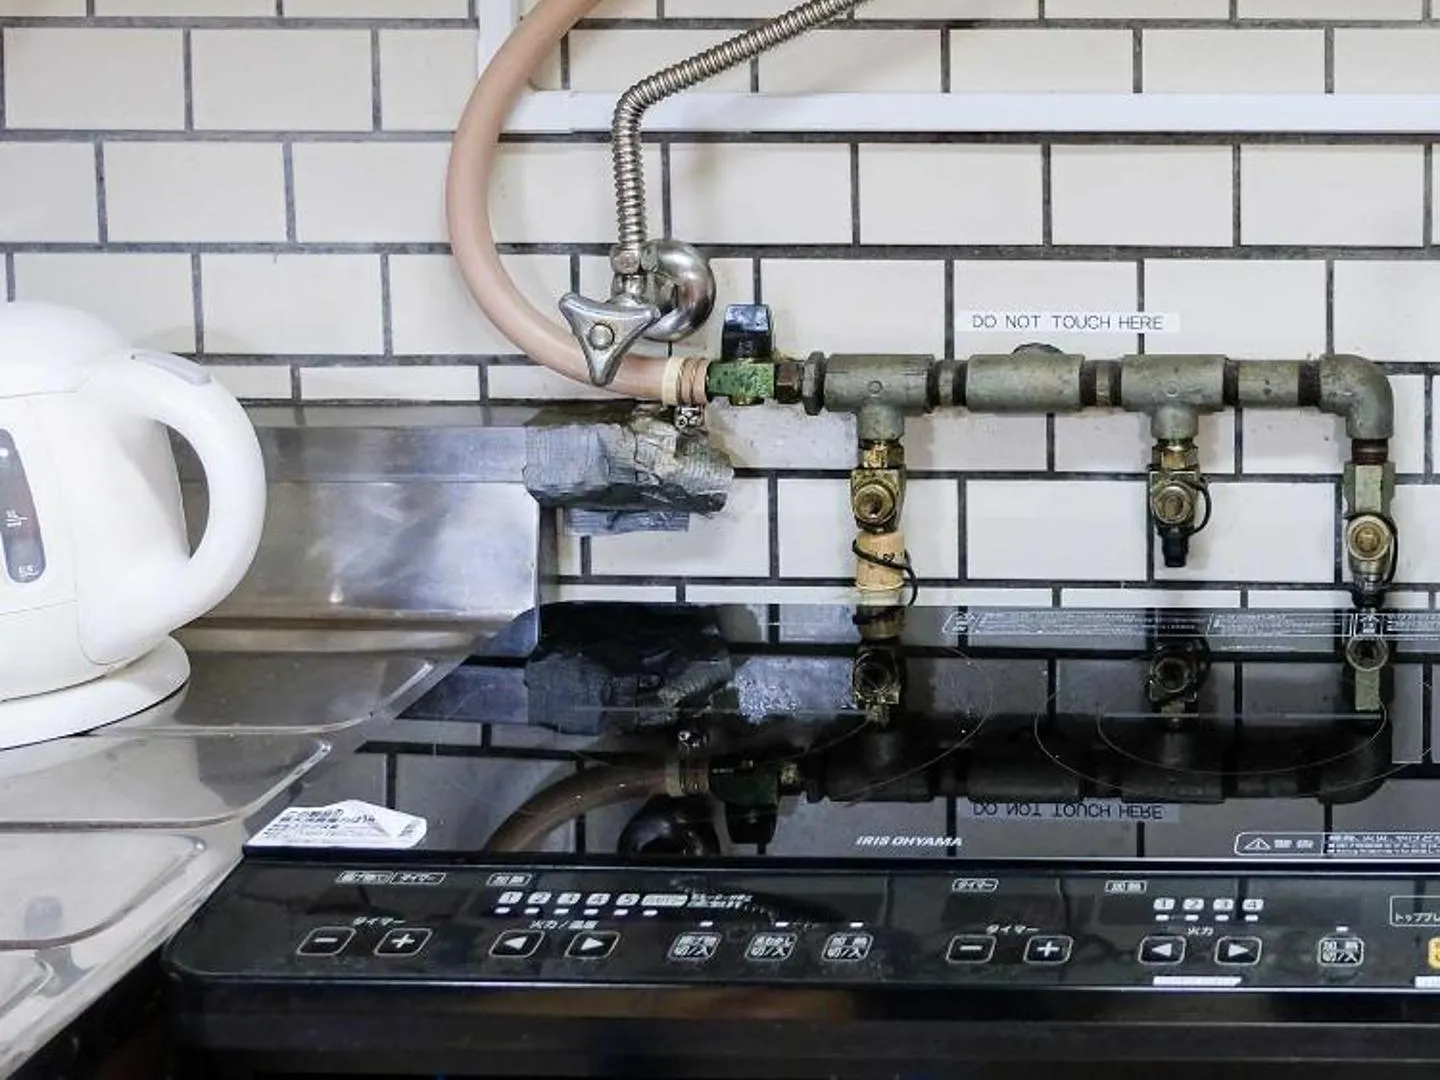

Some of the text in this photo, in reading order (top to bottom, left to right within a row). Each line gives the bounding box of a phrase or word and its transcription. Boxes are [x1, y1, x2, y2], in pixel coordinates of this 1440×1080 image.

[972, 315, 1164, 331] DO NOT TOUCH HERE
[856, 835, 963, 847] IRIS OHYAMA
